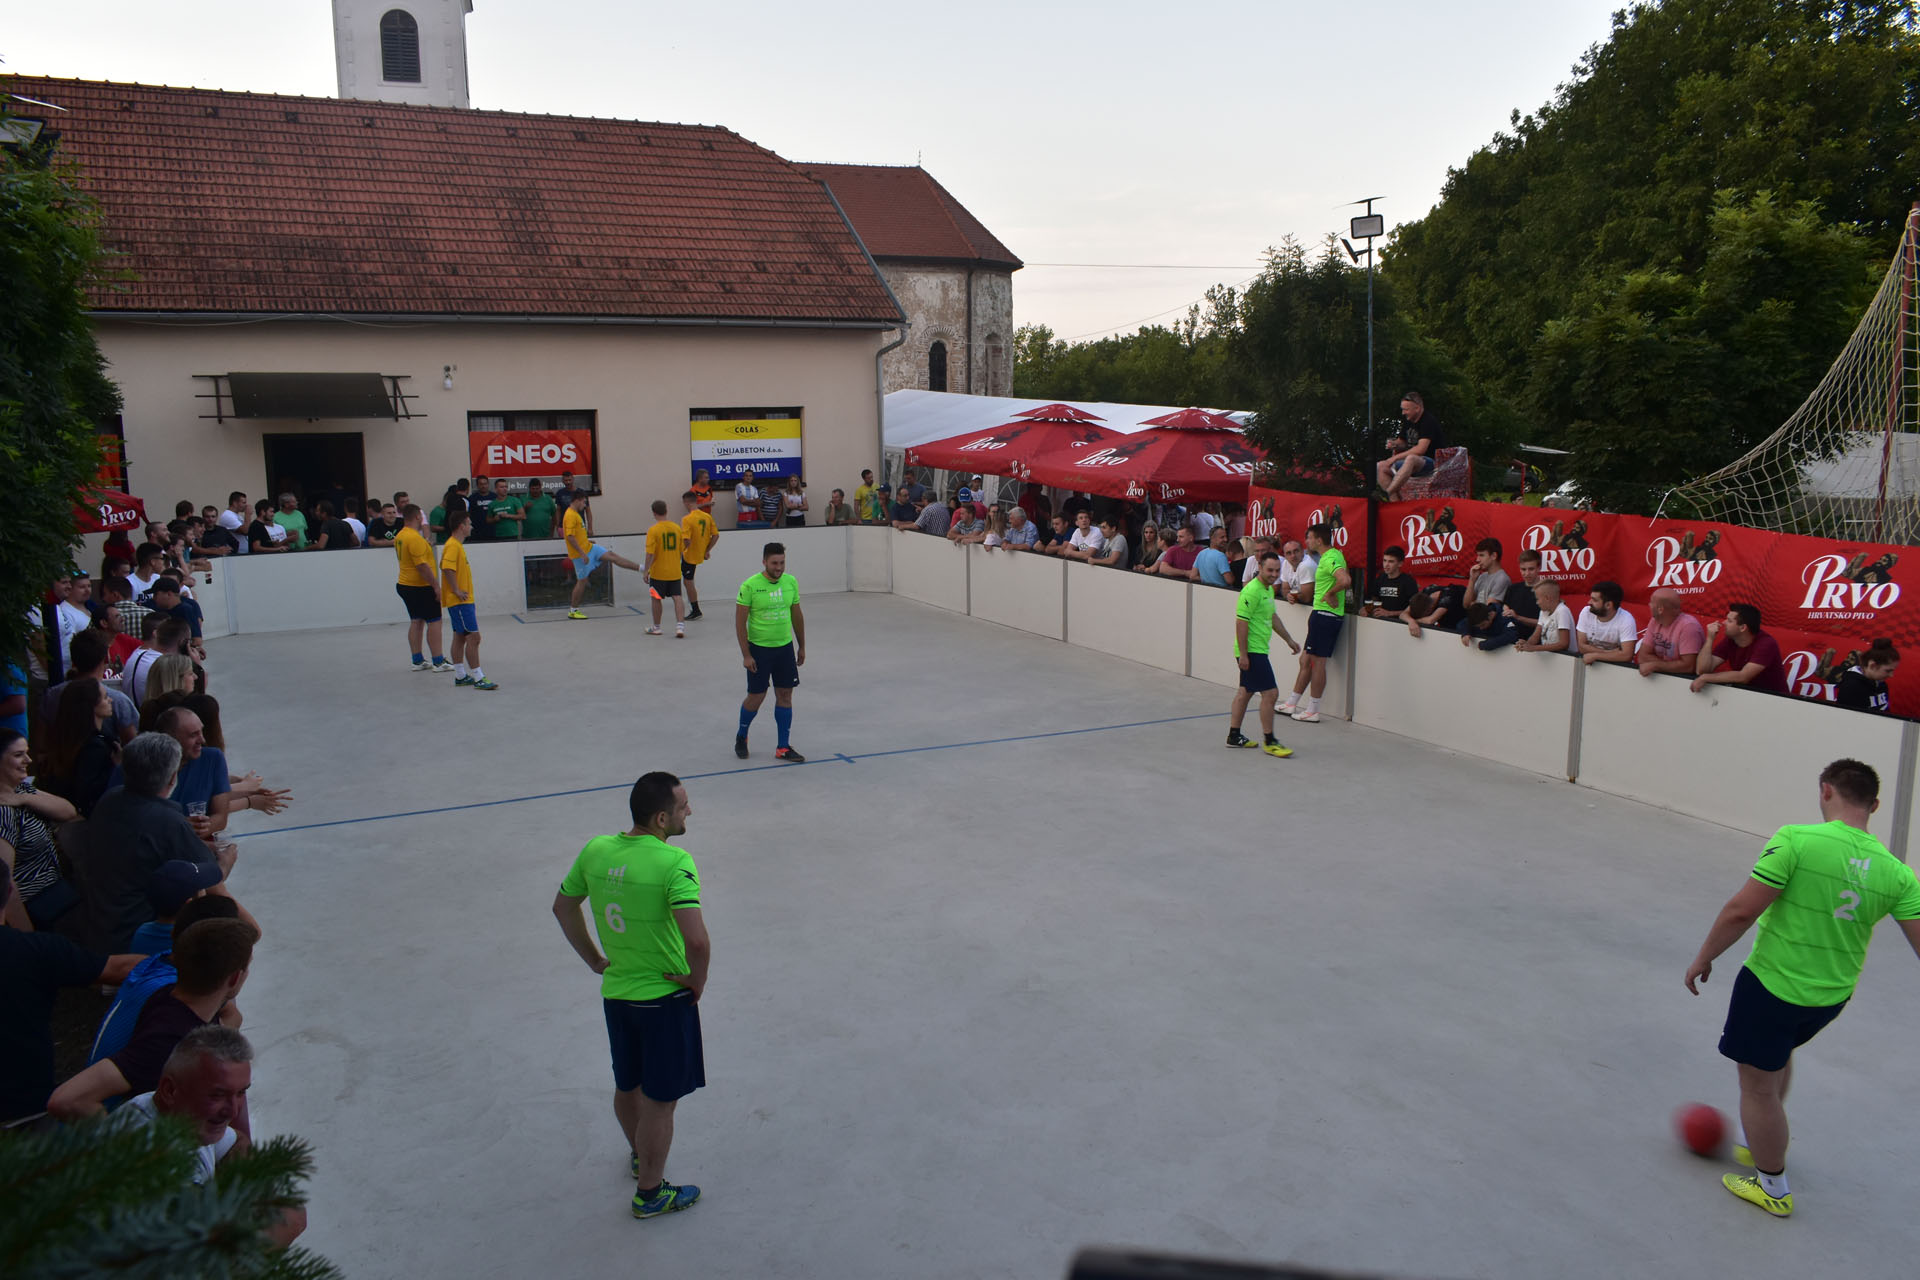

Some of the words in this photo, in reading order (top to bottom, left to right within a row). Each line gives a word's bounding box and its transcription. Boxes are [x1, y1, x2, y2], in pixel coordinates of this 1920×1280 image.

[487, 443, 577, 464] ENEOS
[717, 447, 765, 456] UNIJABETON
[716, 464, 731, 473] P-2
[698, 519, 706, 536] 7
[1400, 514, 1463, 558] PRVO
[661, 532, 677, 551] 10
[1645, 536, 1722, 588] PRVO
[1799, 554, 1901, 609] PRVO
[1807, 611, 1852, 619] HRVATSKO
[1852, 612, 1875, 620] PIVO
[1833, 889, 1861, 921] 2
[604, 902, 627, 934] 6
